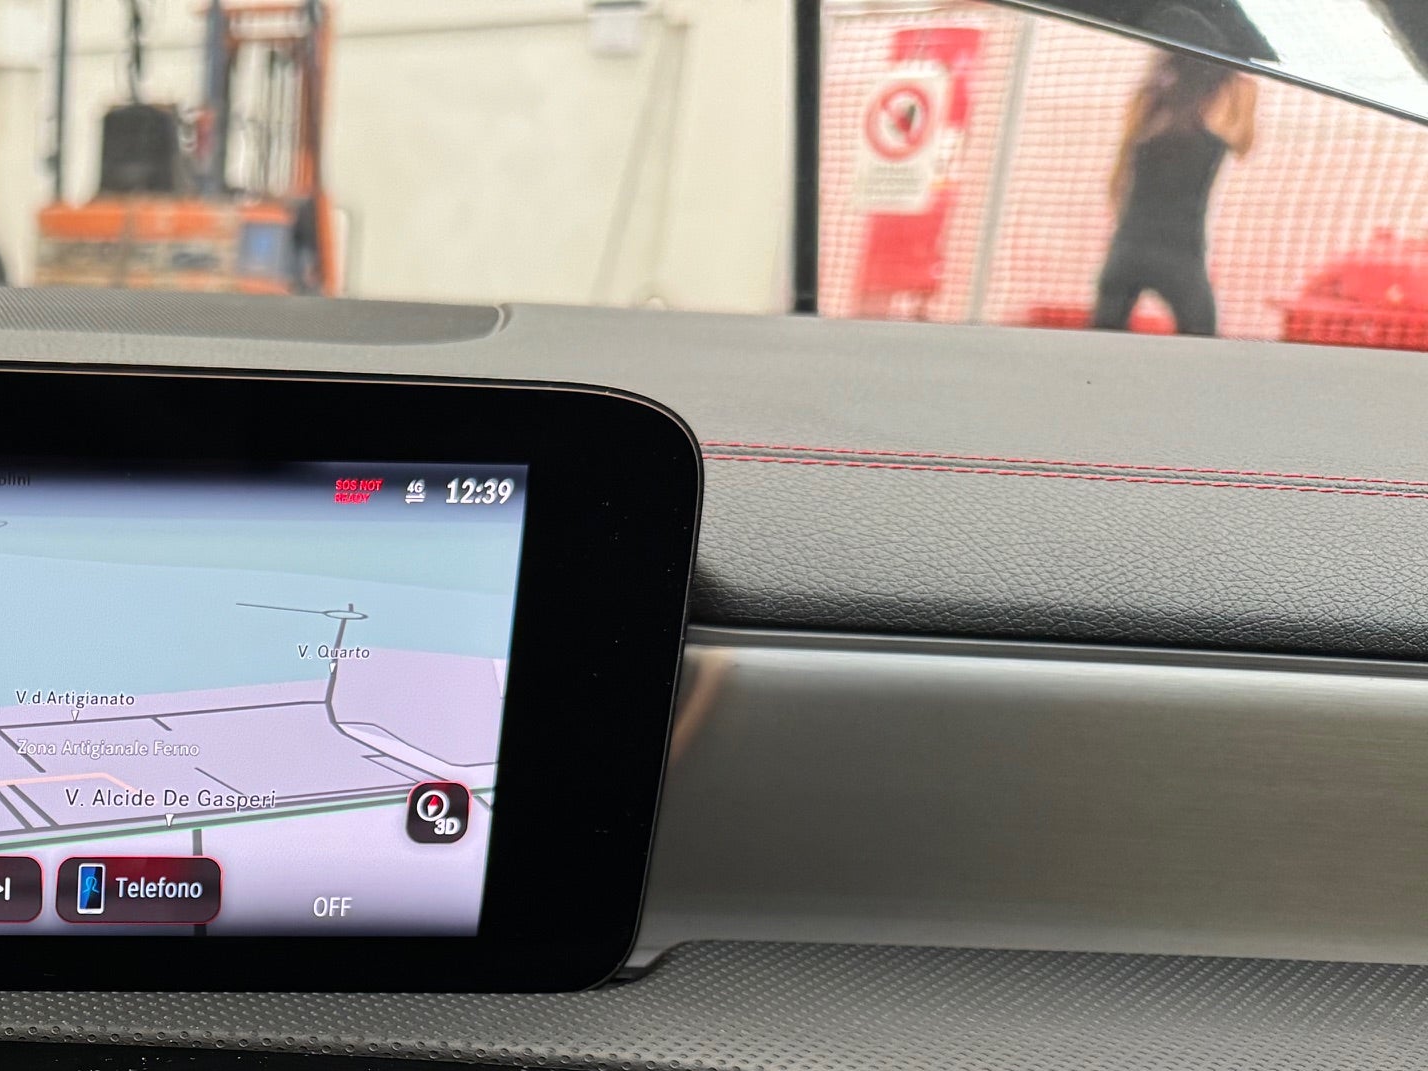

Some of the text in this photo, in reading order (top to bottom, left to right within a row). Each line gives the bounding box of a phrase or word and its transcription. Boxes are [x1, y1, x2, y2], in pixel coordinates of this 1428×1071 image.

[335, 478, 383, 491] SOS NOT
[406, 479, 425, 493] 4G
[446, 477, 515, 504] 12:39
[334, 492, 370, 504] READY
[298, 645, 370, 659] V. Quarto
[17, 739, 200, 760] Zona Artigianale Ferno
[66, 789, 276, 813] V. Alcide De Gasperi
[433, 817, 461, 835] 3D
[115, 876, 203, 899] Telefono
[313, 896, 352, 917] OFF
